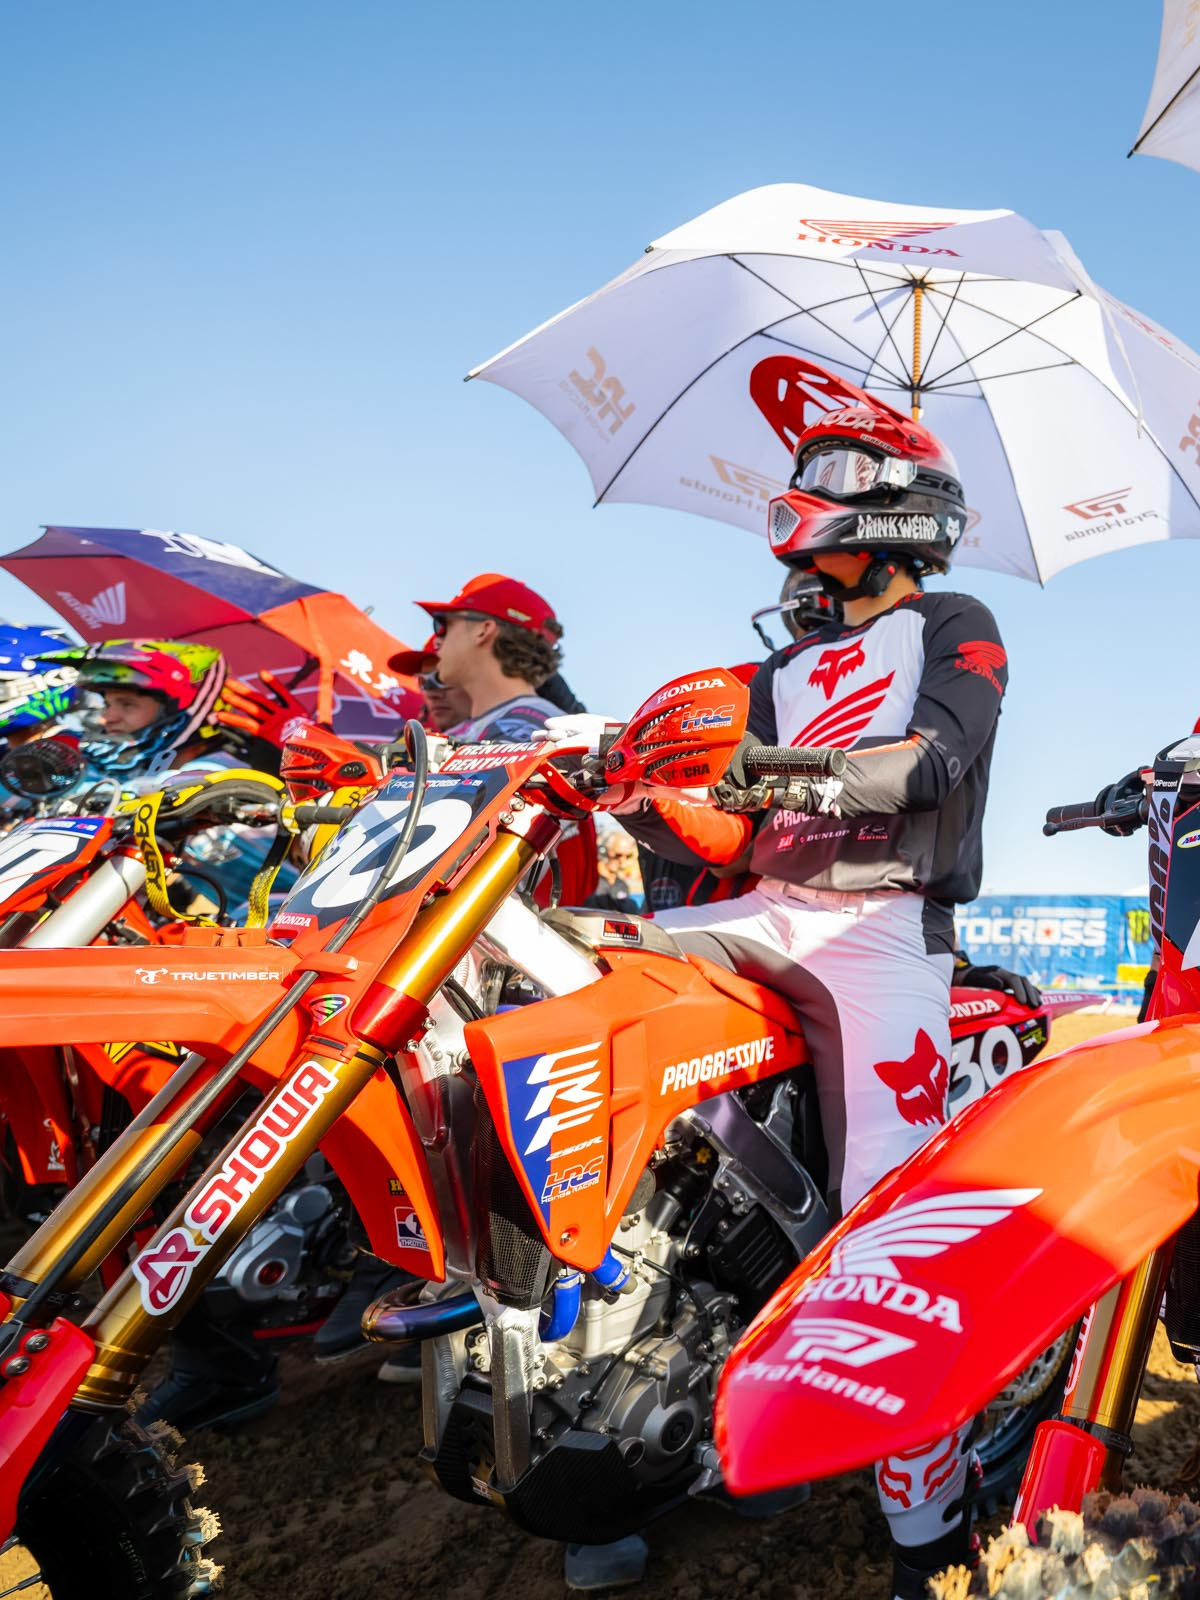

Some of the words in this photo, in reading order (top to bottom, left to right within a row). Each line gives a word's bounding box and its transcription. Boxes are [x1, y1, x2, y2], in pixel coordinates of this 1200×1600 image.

[795, 233, 966, 258] HONDA
[857, 514, 897, 540] DRINK
[898, 514, 939, 541] WEIRD
[657, 677, 726, 704] HONDA
[170, 971, 280, 981] TRUETIMBER
[660, 1036, 775, 1096] PROGRESSIVE
[187, 1063, 335, 1240] SHOWA
[792, 1275, 964, 1334] HONDA
